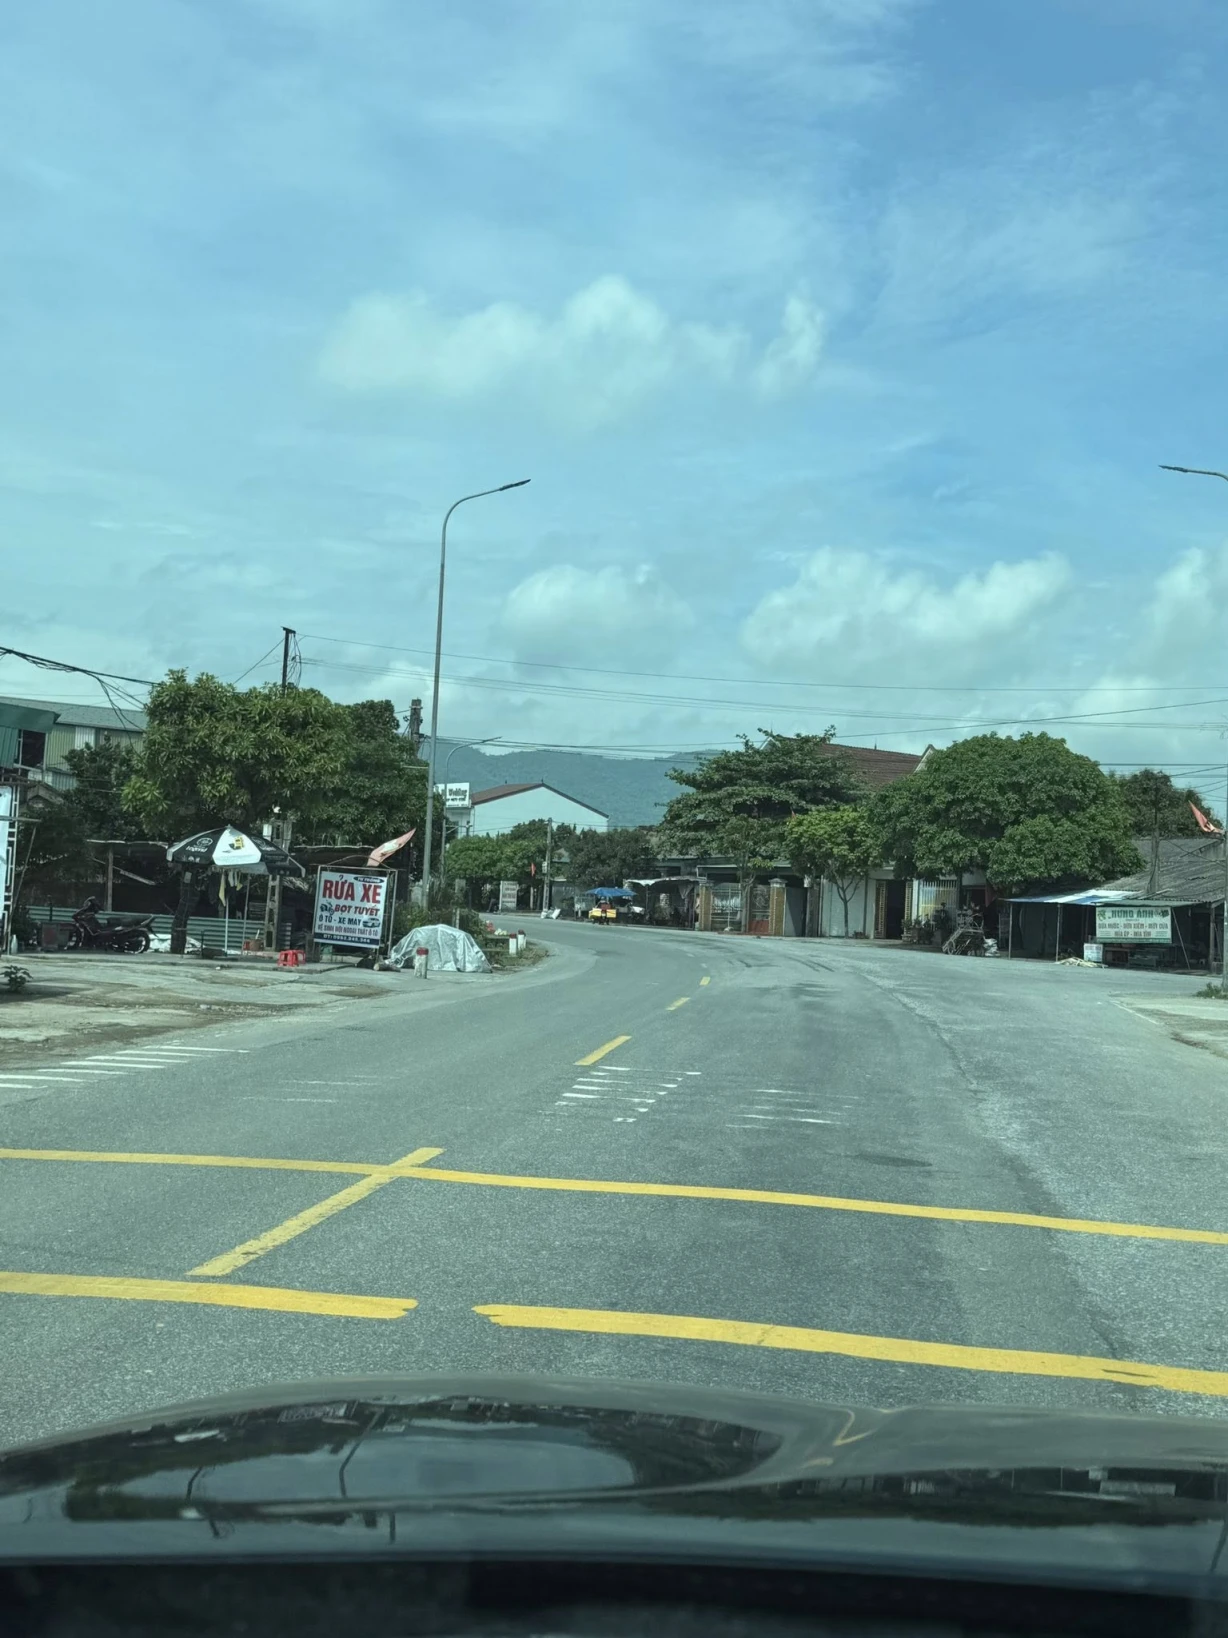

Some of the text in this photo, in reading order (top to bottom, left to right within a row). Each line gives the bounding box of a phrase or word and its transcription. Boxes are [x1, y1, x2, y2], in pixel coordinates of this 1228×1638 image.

[322, 875, 382, 904] RỬA XE
[334, 904, 380, 916] BỌT TUYẾT
[338, 916, 346, 924] XE
